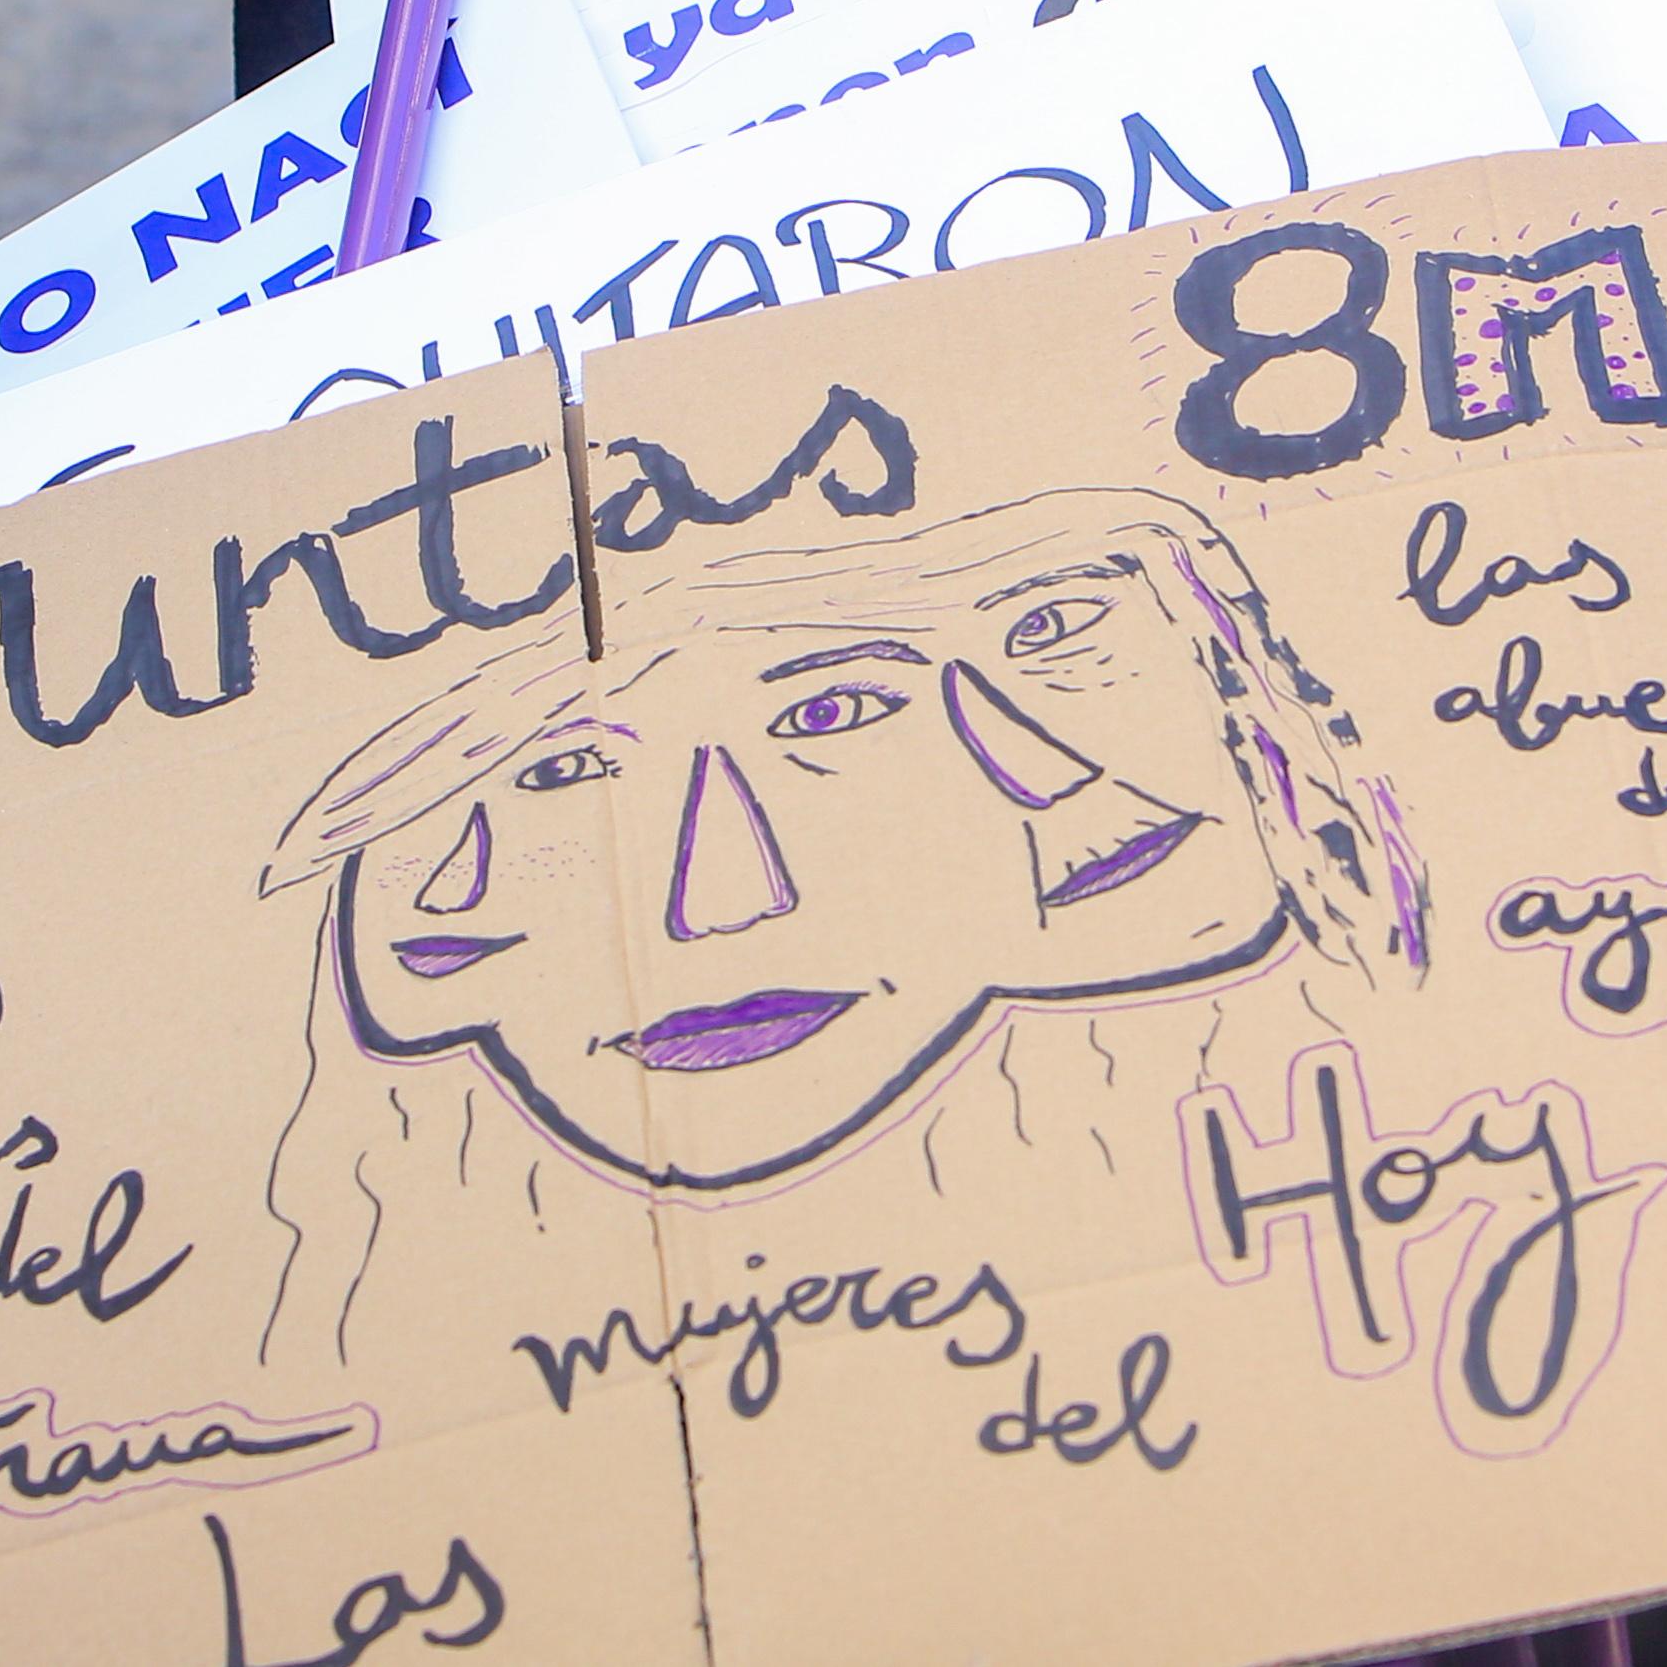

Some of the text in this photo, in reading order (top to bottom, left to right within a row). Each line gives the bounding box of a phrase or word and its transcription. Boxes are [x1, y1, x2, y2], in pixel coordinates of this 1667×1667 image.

[1206, 1066, 1642, 1416] Hoy
[512, 1254, 1025, 1417] mujeres
[978, 1333, 1198, 1470] del
